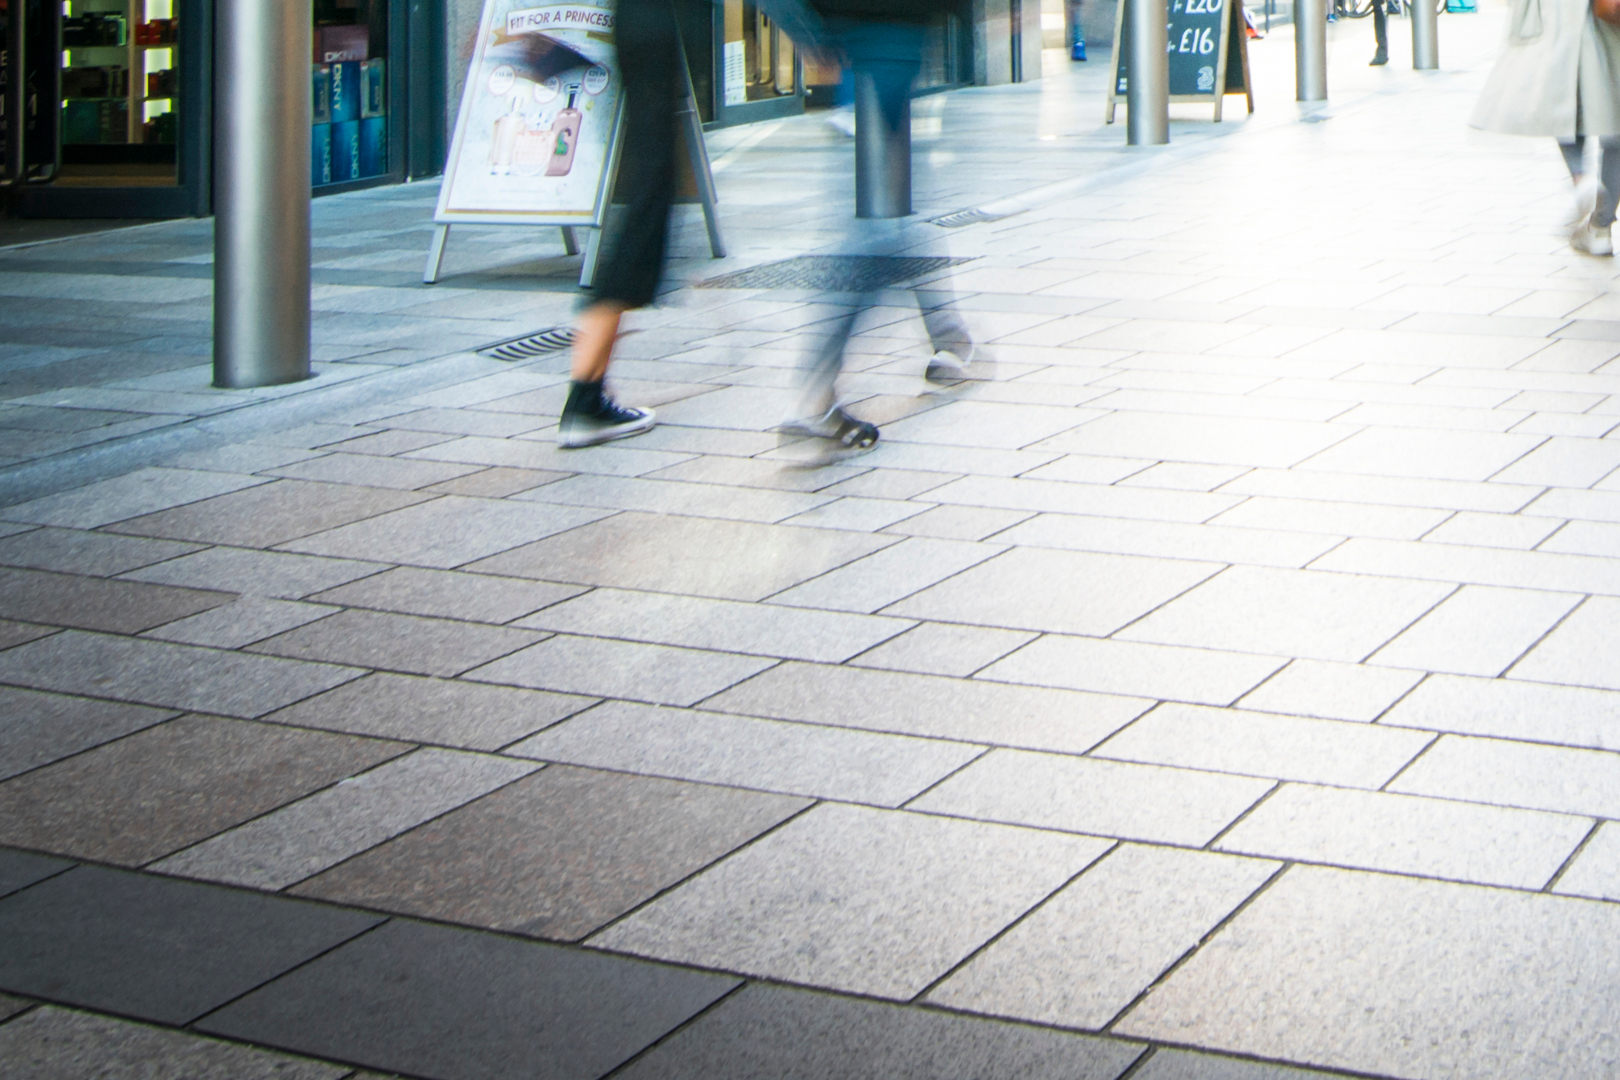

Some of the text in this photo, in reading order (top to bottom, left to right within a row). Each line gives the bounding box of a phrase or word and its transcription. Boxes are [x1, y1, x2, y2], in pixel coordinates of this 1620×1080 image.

[510, 10, 615, 30] FIT FOR A PRINCESS
[1179, 27, 1214, 55] £16
[333, 64, 342, 111] DKNY
[323, 138, 331, 183] DKNY
[351, 134, 359, 178] DKNY
